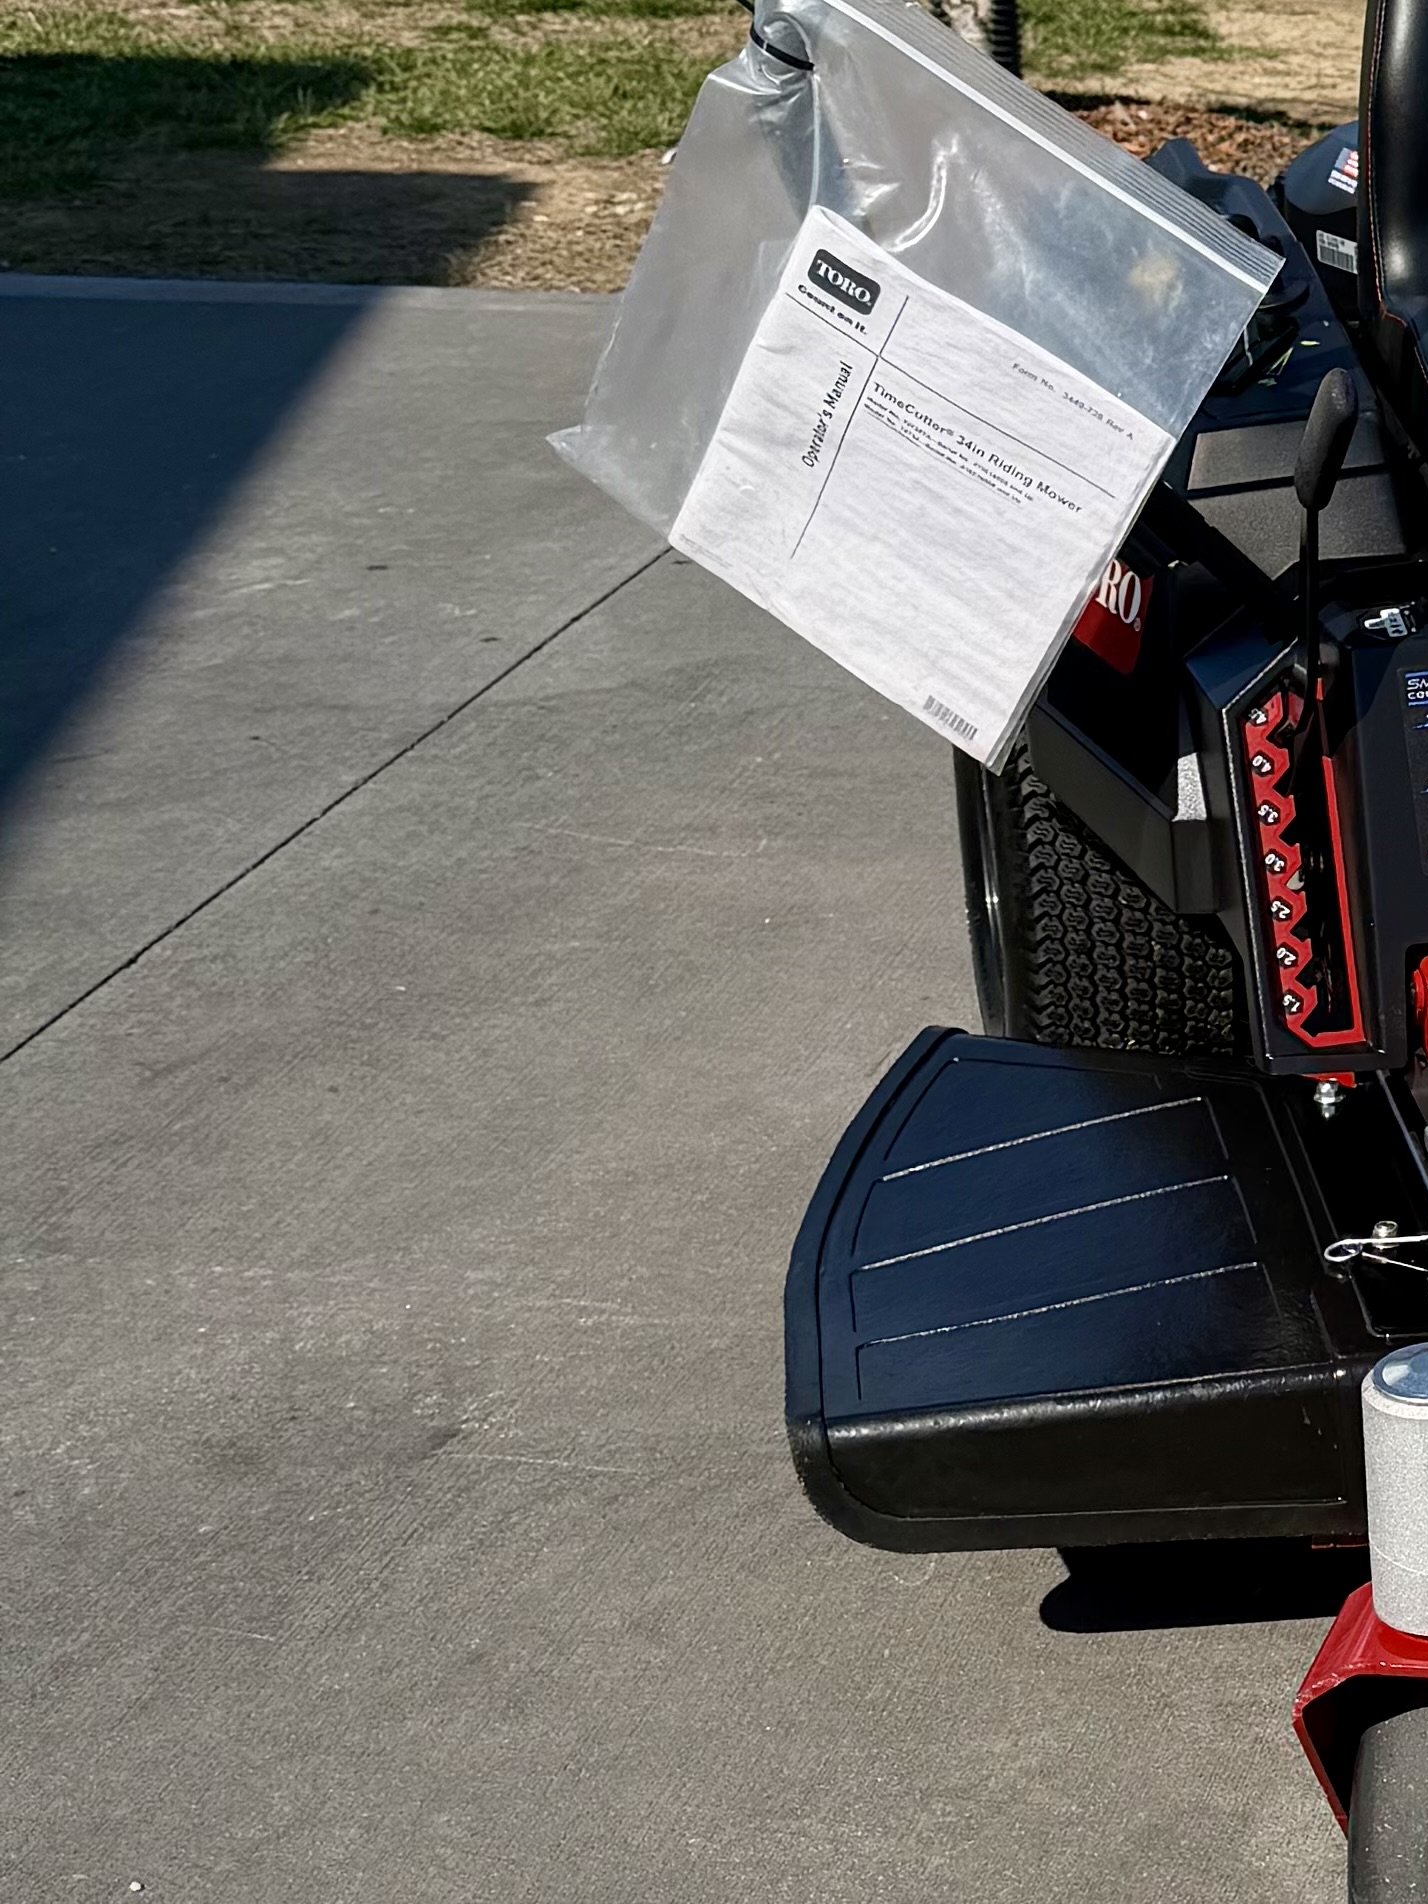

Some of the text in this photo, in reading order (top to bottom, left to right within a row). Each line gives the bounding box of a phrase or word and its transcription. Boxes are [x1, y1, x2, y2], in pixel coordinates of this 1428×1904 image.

[798, 284, 836, 314] Count
[816, 260, 872, 304] TORO
[1012, 362, 1038, 382] Form
[801, 360, 853, 468] Operator's Manual
[988, 453, 1034, 488] Riding
[1036, 481, 1083, 514] Mower
